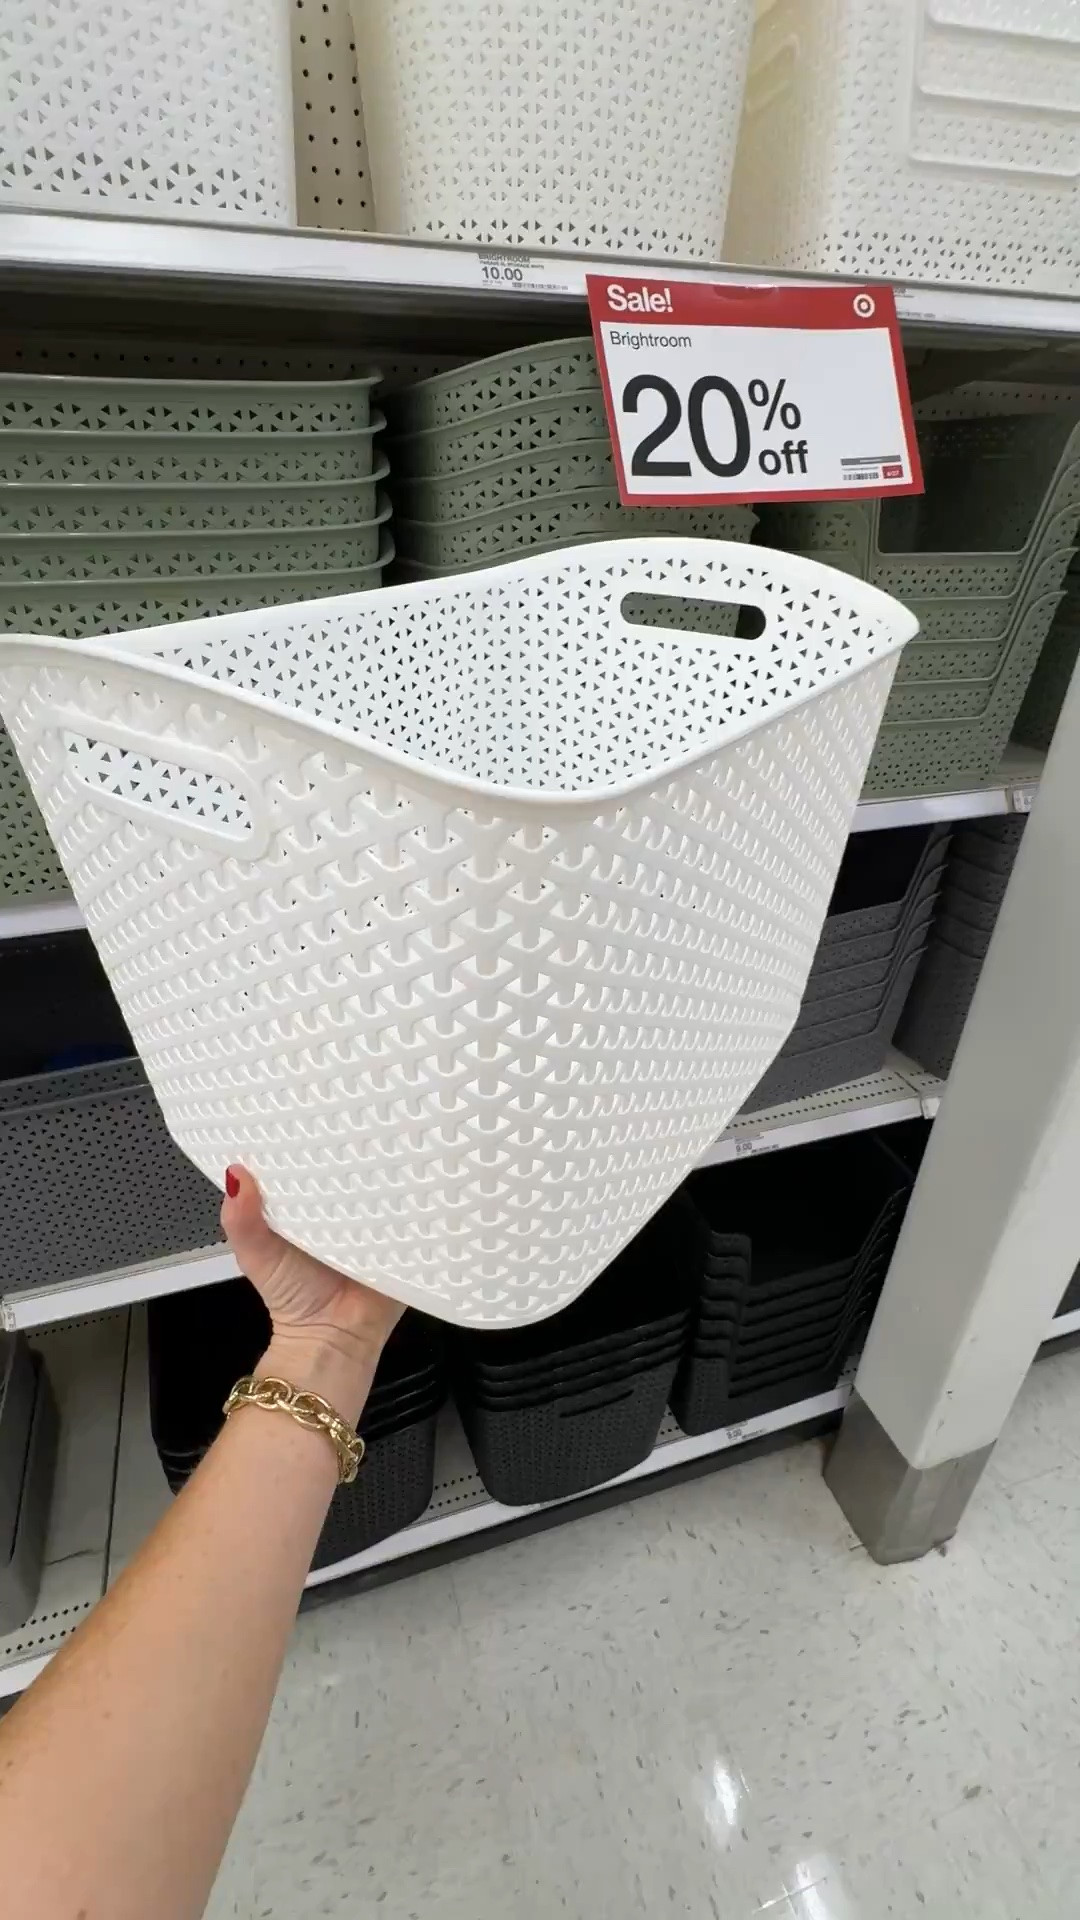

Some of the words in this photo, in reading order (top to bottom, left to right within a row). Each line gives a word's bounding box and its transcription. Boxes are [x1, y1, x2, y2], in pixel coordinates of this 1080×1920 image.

[482, 266, 523, 281] 10.00
[607, 284, 673, 313] Sale!
[609, 330, 692, 350] Brightroom
[758, 440, 808, 476] off
